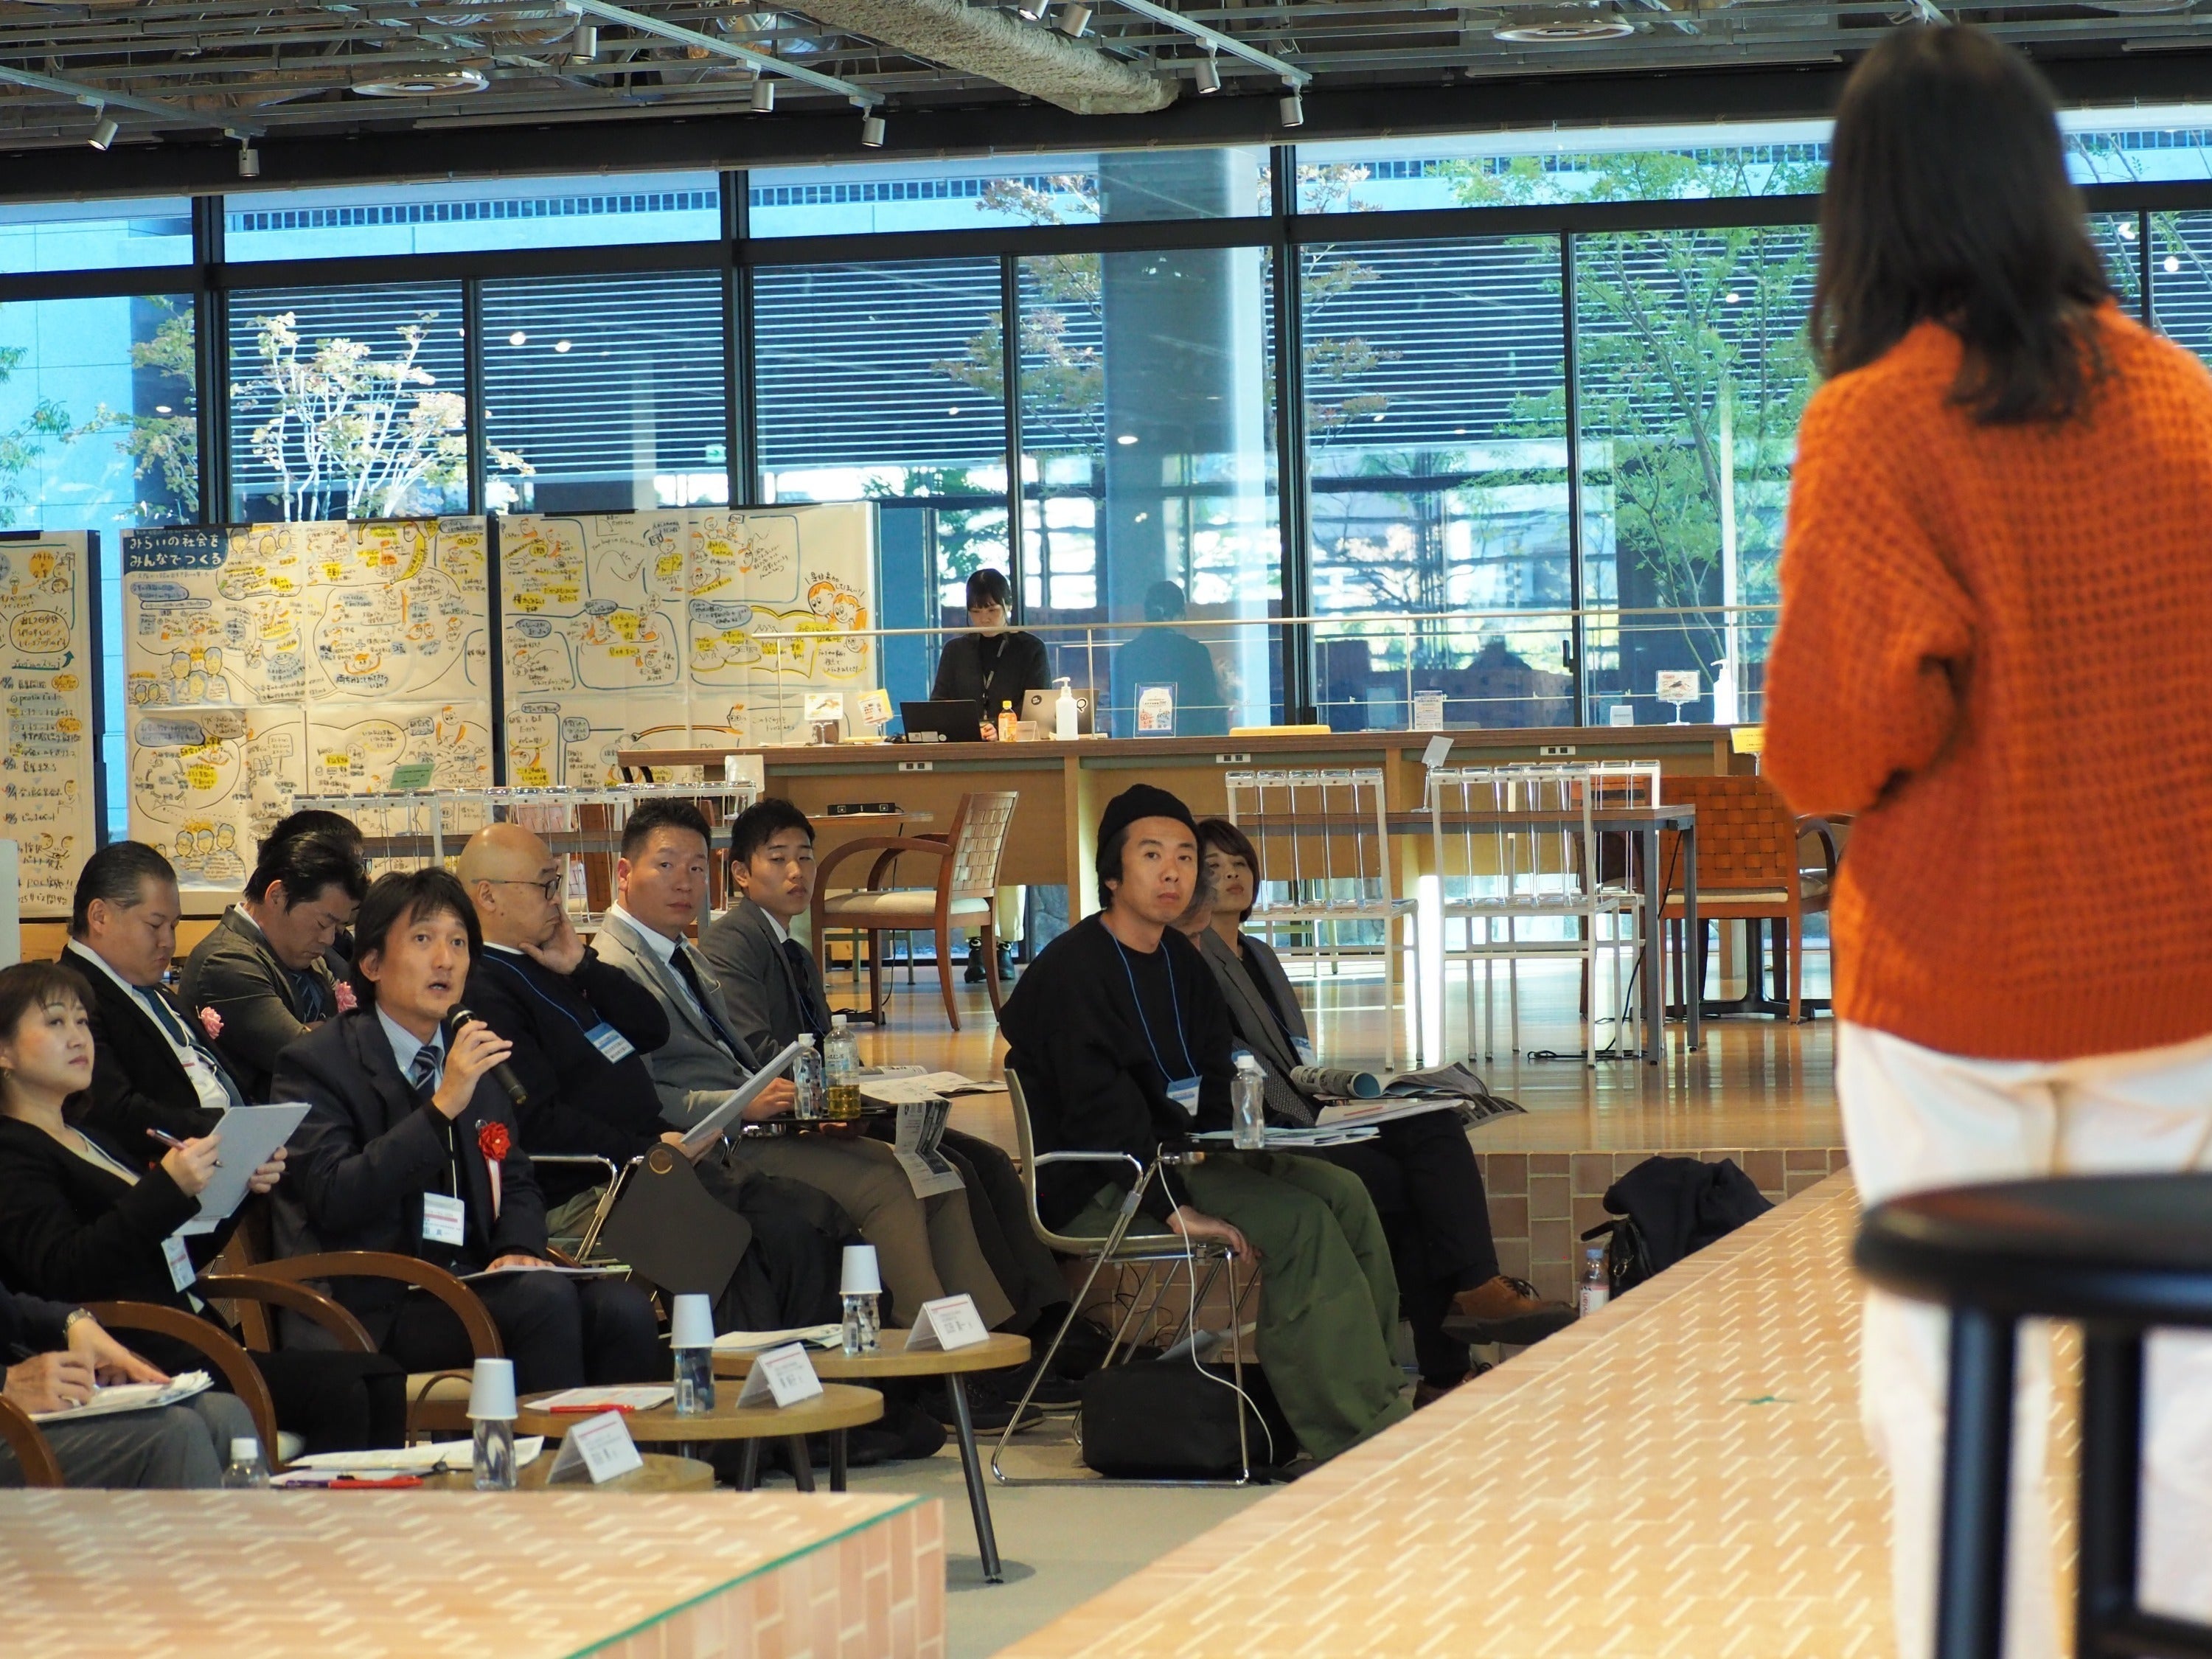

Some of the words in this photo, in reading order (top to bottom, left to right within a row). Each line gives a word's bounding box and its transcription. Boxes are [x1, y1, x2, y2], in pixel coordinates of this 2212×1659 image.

[129, 532, 219, 549] みらいの社会を
[129, 553, 222, 568] みんなでつくる
